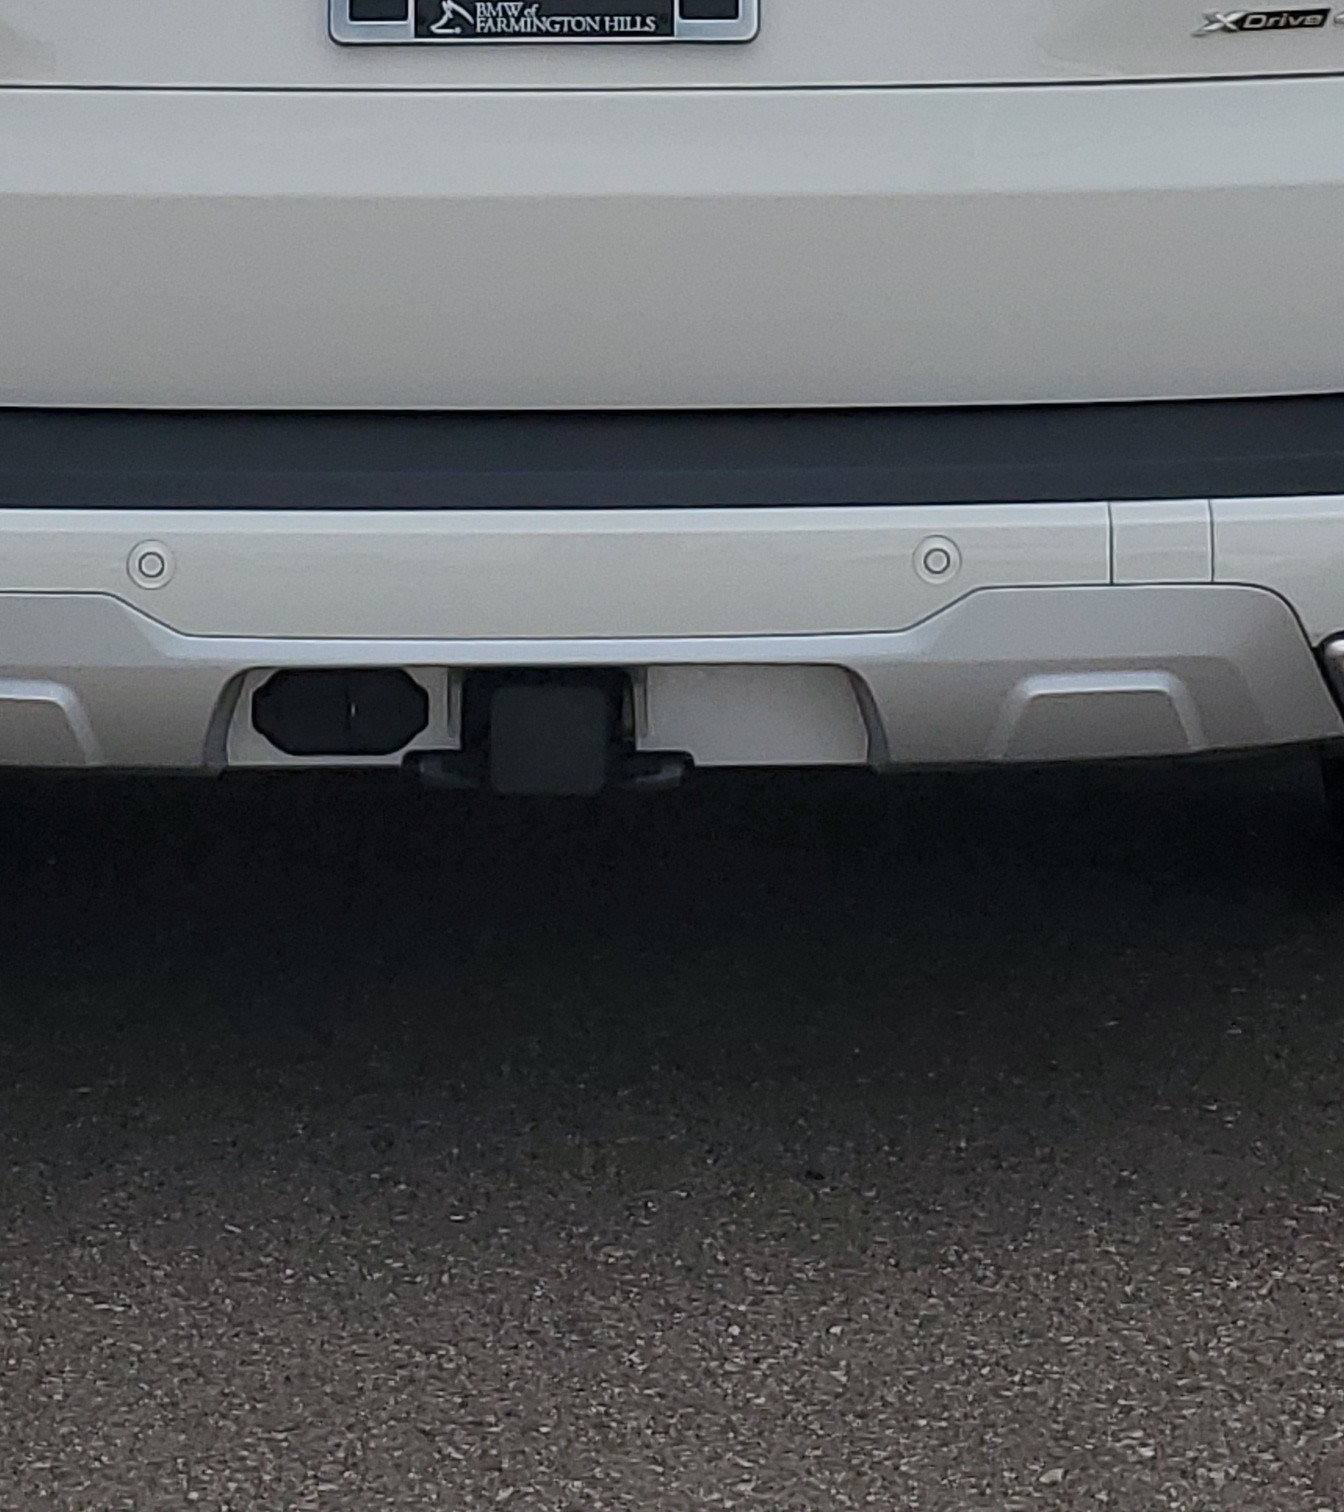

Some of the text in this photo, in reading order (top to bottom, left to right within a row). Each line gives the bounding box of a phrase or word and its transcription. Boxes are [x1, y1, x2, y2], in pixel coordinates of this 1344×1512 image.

[475, 2, 539, 18] BMW of
[475, 16, 656, 33] FARMINGTON HILLS
